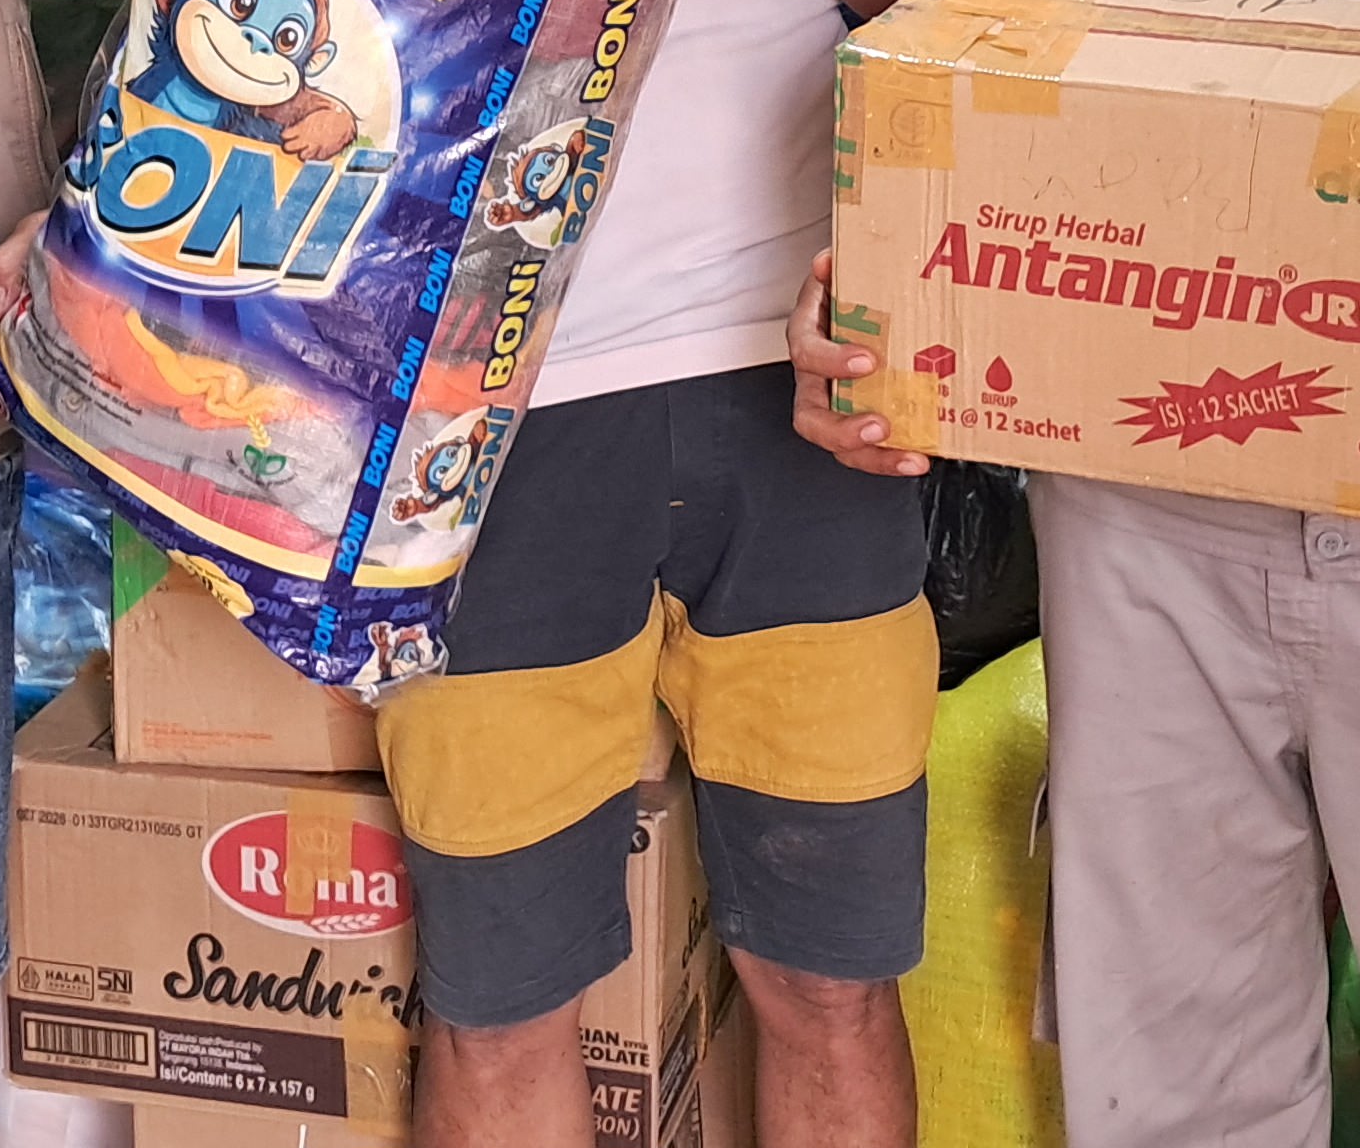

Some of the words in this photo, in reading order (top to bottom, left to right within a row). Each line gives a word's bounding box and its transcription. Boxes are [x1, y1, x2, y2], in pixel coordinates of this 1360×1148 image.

[478, 66, 514, 128] BONI
[450, 156, 484, 219] BONI
[976, 204, 1047, 239] Sirup
[1054, 213, 1146, 247] Herbal
[419, 249, 452, 313] BONI
[920, 222, 1283, 330] Antangin
[392, 336, 425, 402] BONI
[960, 408, 978, 428] @
[984, 411, 1008, 431] 12
[1013, 416, 1081, 442] sachet
[981, 392, 1018, 409] SIRUP
[1158, 403, 1185, 429] ISI
[1198, 395, 1224, 424] 12
[1225, 383, 1301, 419] SACHET
[363, 423, 397, 488] BONI
[336, 512, 369, 574] BONI
[186, 825, 202, 839] GT
[240, 845, 399, 908] Rma
[45, 970, 89, 984] HALAL
[98, 967, 132, 993] SNI
[160, 1064, 233, 1088] Isi/Content:
[235, 1074, 244, 1090] 6
[246, 1079, 255, 1091] x
[257, 1077, 266, 1092] 7
[269, 1081, 278, 1094] x
[280, 1079, 303, 1097] 157
[305, 1085, 316, 1103] g
